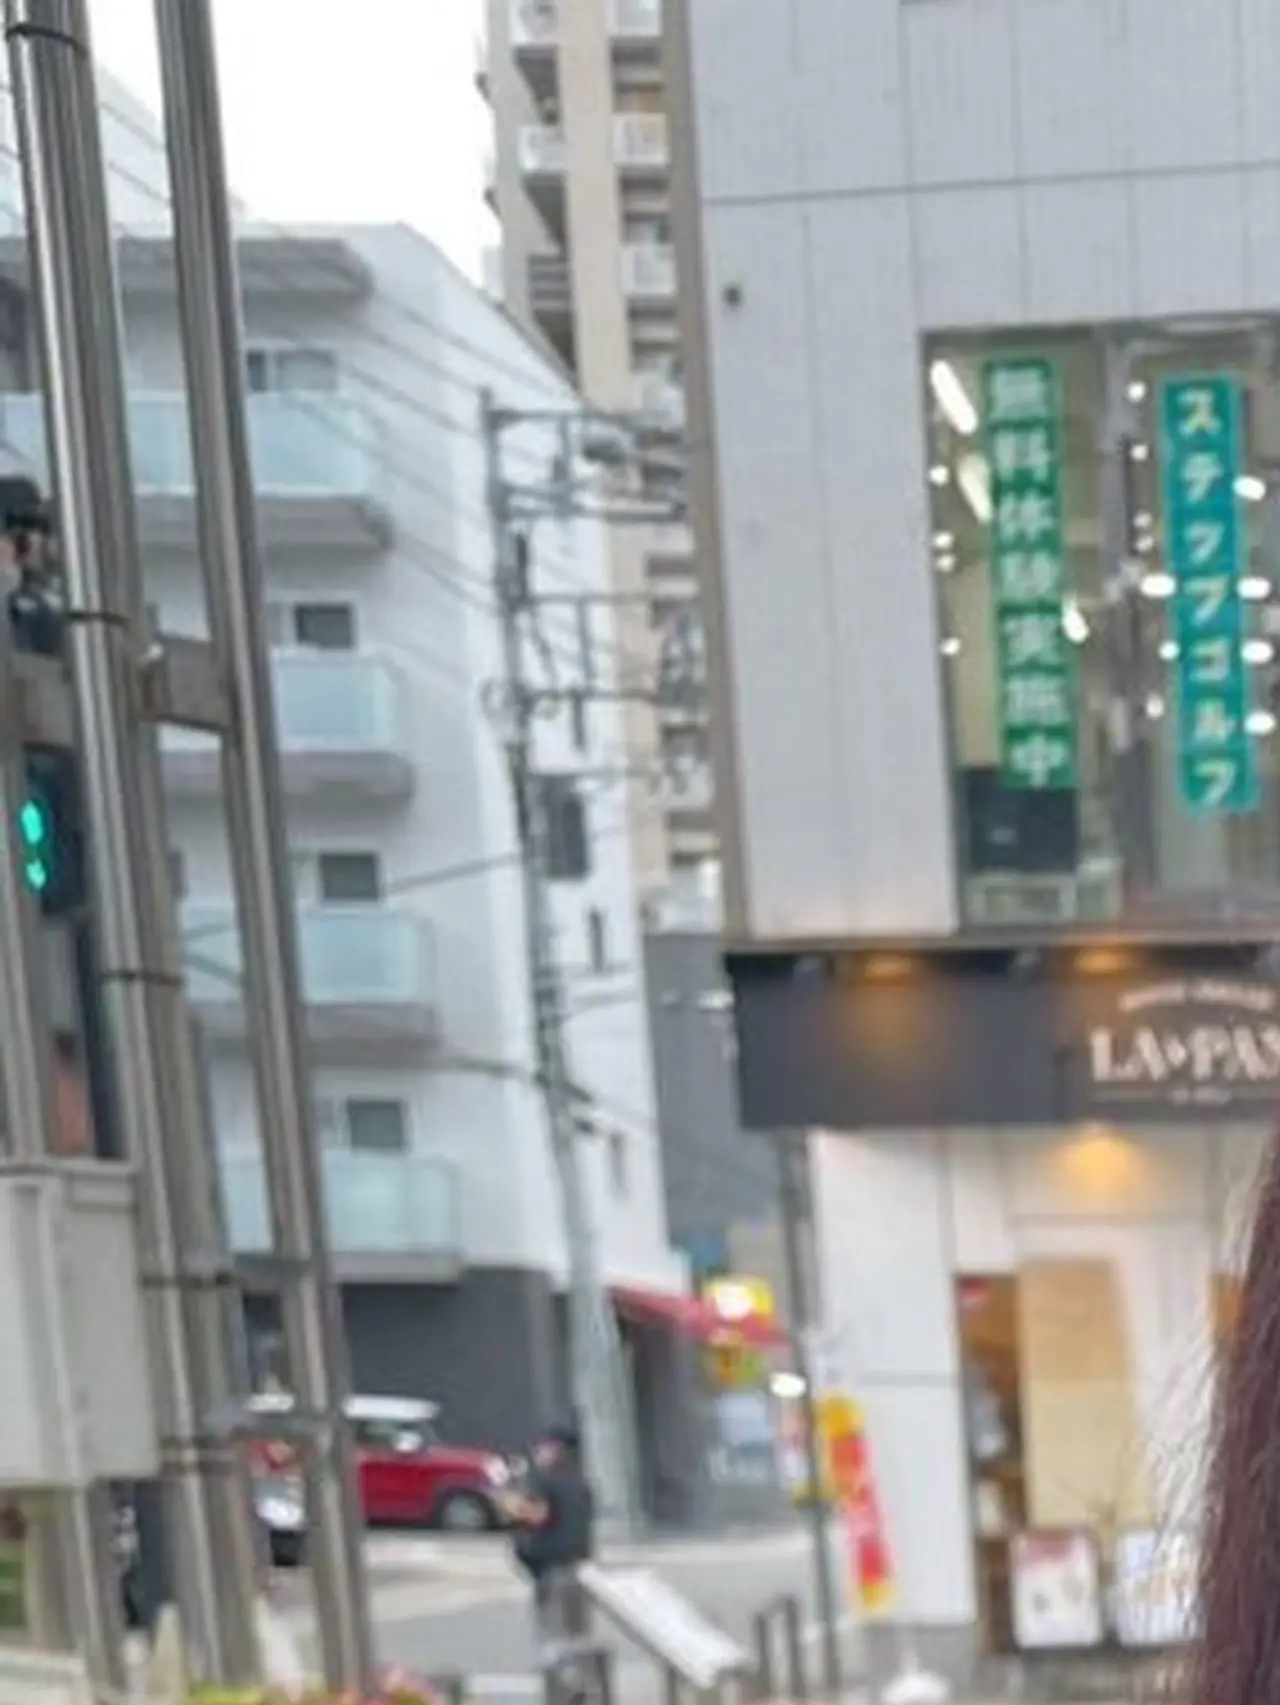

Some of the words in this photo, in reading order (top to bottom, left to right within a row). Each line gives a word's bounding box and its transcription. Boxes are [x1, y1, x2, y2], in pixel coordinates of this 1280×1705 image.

[1175, 388, 1237, 804] ステップゴルフ
